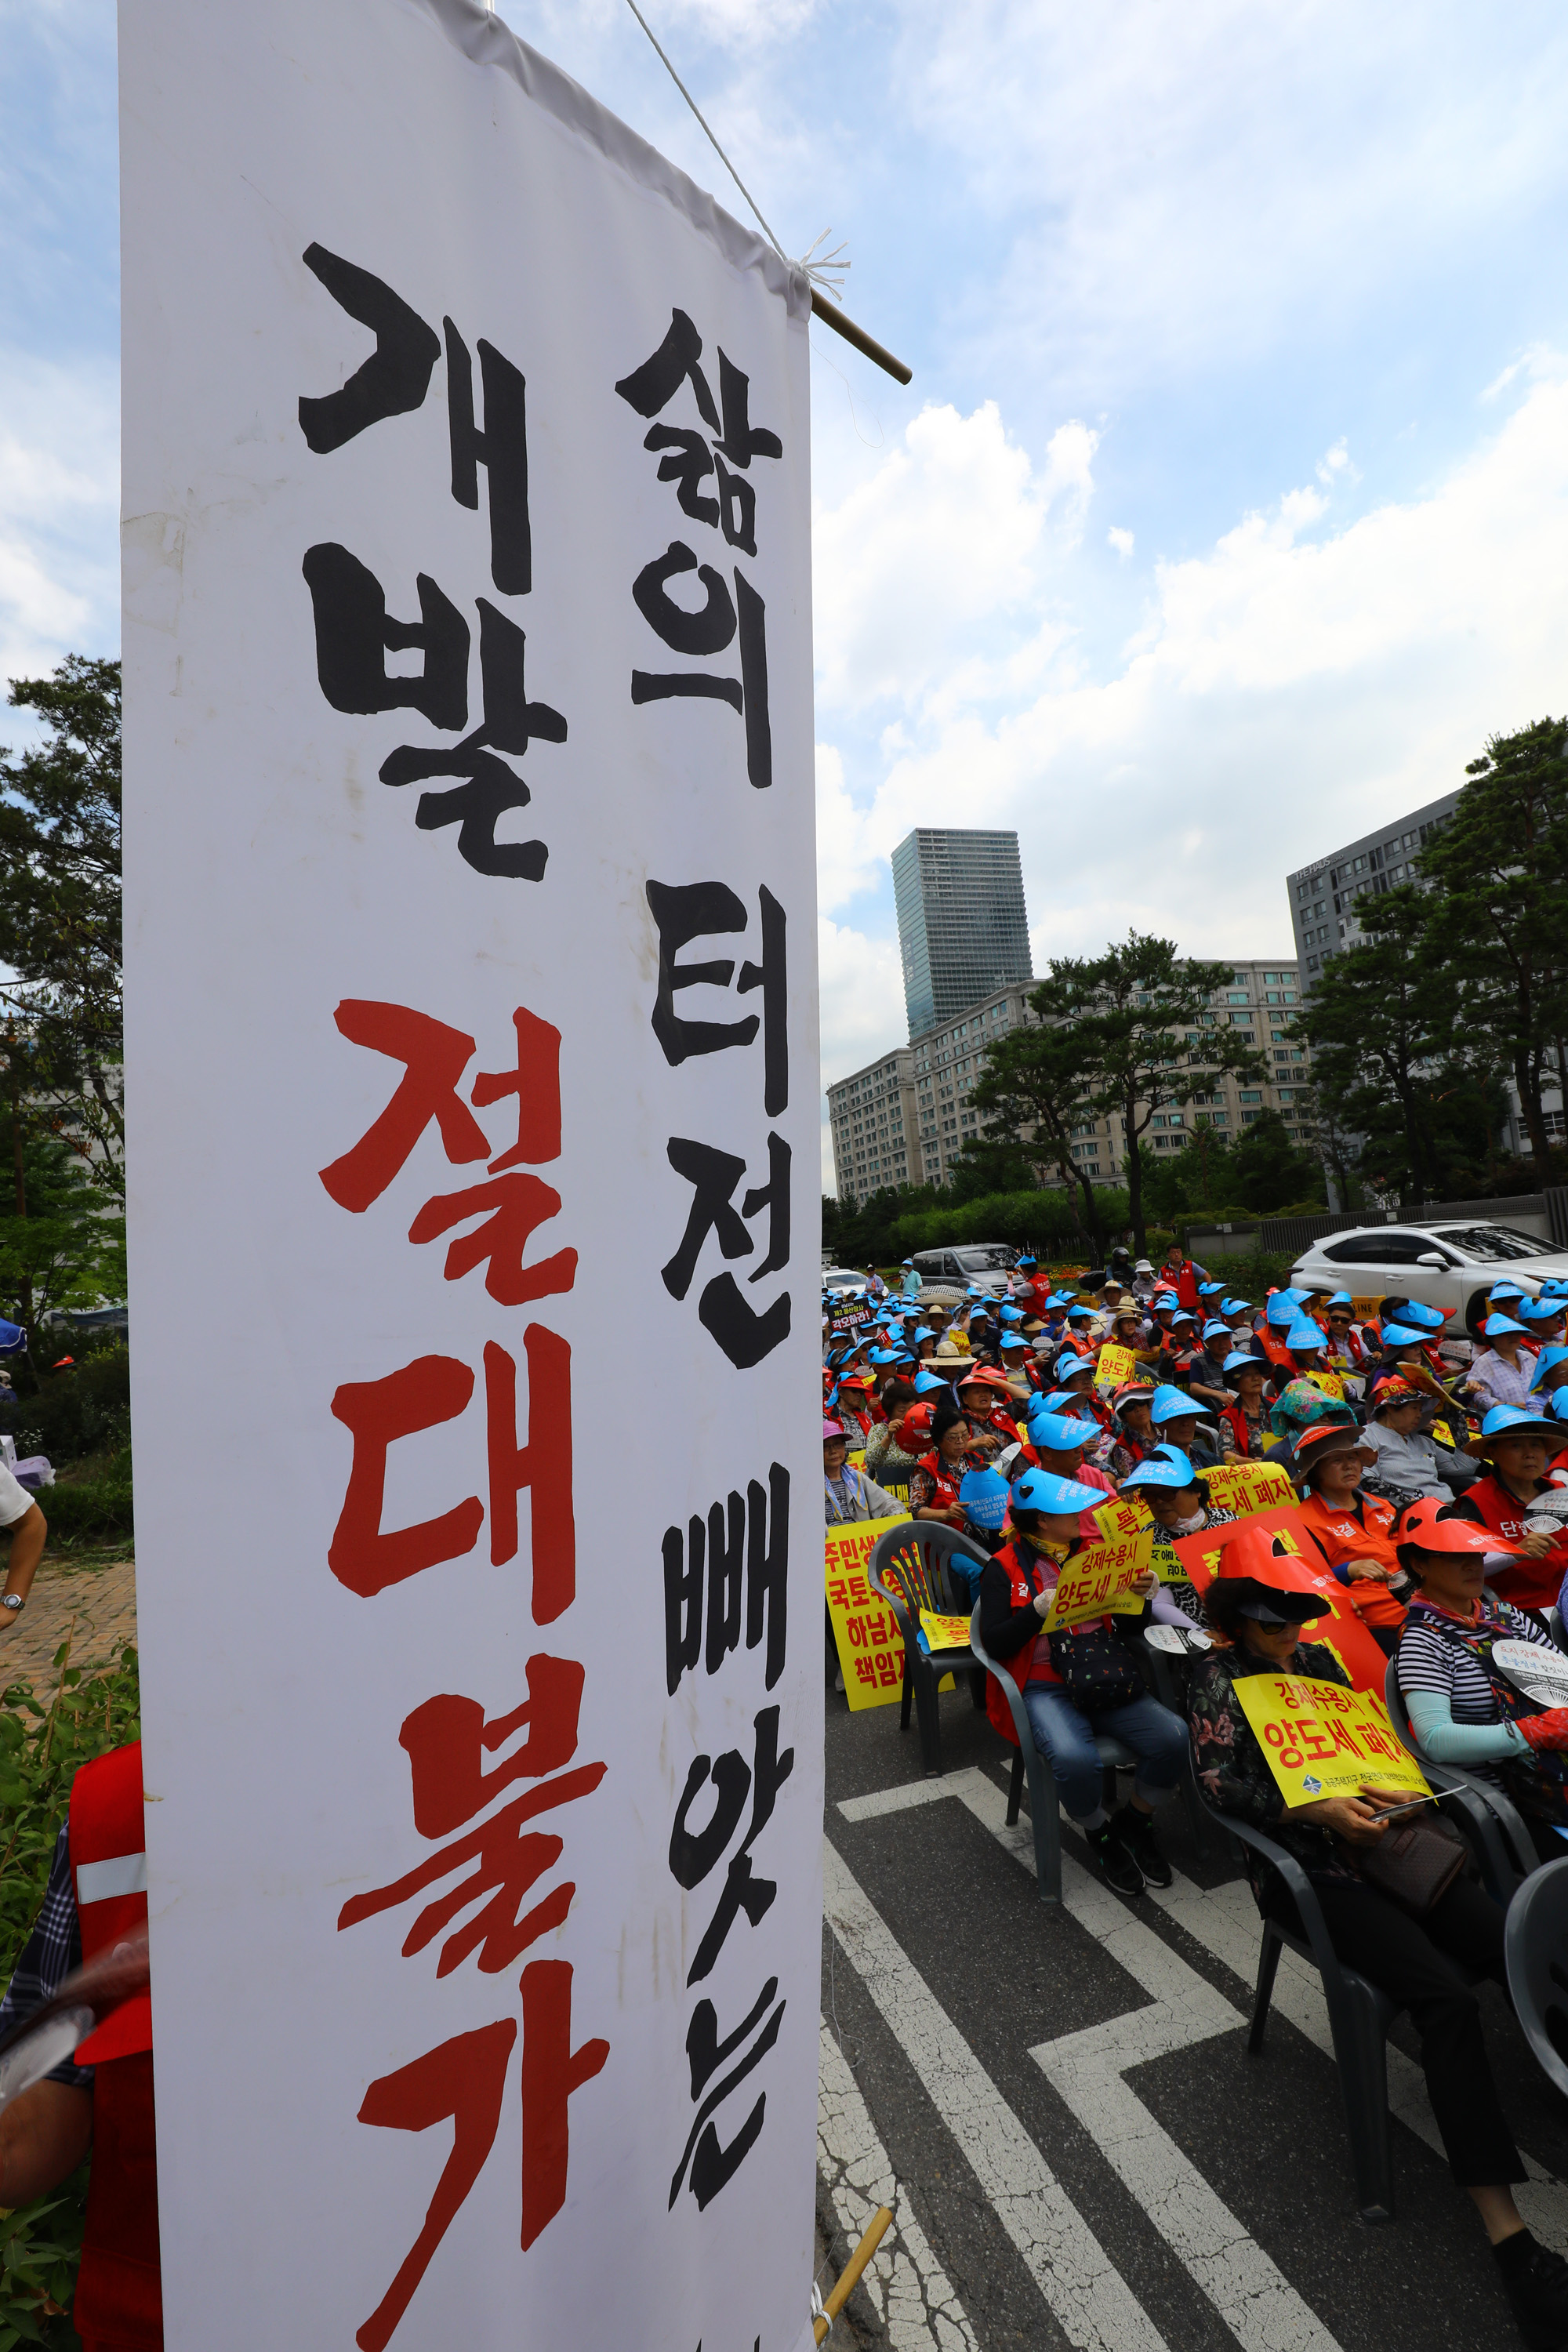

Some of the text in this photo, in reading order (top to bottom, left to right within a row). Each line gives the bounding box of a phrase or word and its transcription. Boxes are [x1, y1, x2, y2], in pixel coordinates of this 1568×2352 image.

[299, 242, 568, 882] 개발
[615, 308, 783, 789] 삶의
[1295, 867, 1309, 881] THE
[1309, 857, 1330, 873] HAUS
[647, 880, 792, 1370] 터전
[1205, 1465, 1264, 1490] 강제수용시
[1253, 1474, 1294, 1505] 폐지
[1326, 1521, 1357, 1537] 단결
[1081, 1542, 1138, 1575] 강제수용시
[1011, 1581, 1029, 1599] 결
[1055, 1573, 1112, 1615] 양도세
[1275, 1681, 1366, 1715] 강제수용시
[1264, 1718, 1419, 1770] 양도세 폐지
[1323, 1774, 1359, 1788] 공공주택지구
[662, 1462, 794, 2212] 빼앗는
